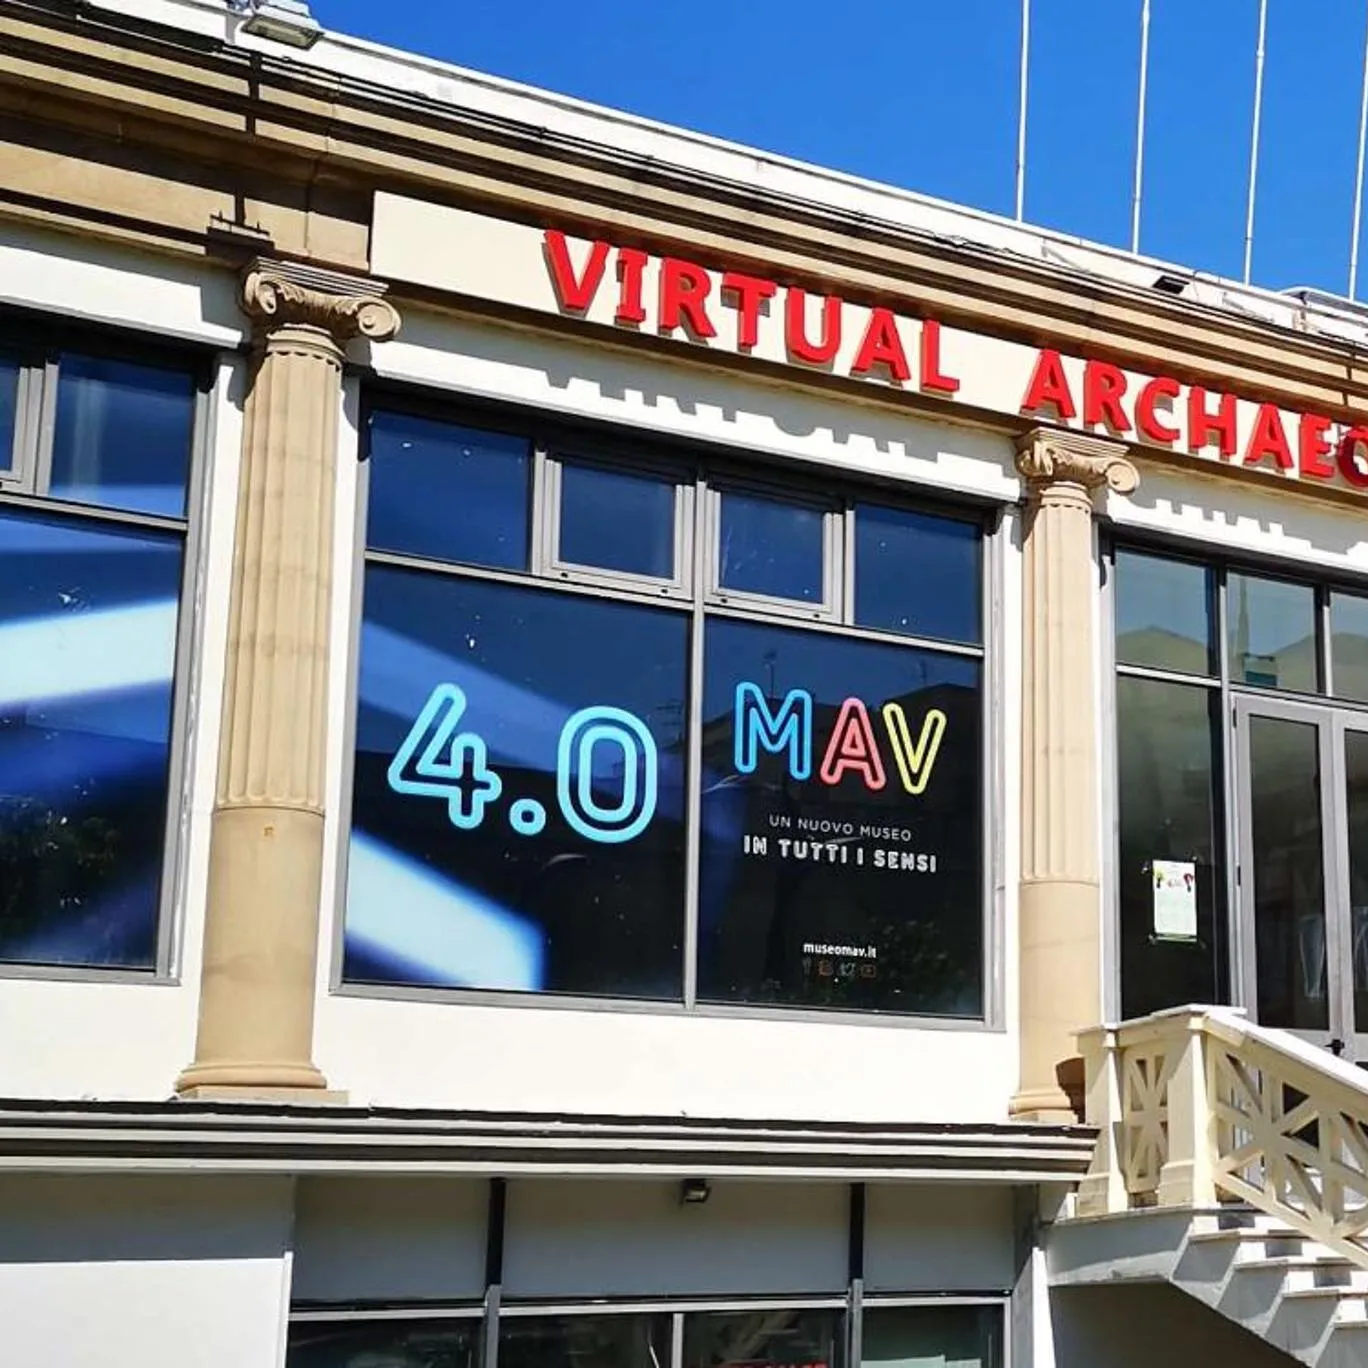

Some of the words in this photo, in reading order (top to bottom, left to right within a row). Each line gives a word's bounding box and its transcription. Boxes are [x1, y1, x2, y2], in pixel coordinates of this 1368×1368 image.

[543, 228, 961, 394] VIRTUAL
[387, 682, 658, 844] 4.0
[734, 681, 947, 795] MAV
[744, 835, 767, 855] IN
[778, 838, 847, 864] TUTTI
[856, 847, 864, 865] I
[873, 849, 937, 873] SENSI
[769, 814, 791, 828] UN
[798, 818, 853, 835] NUOVO
[860, 825, 912, 842] MUSEO
[803, 942, 877, 958] museomav.it
